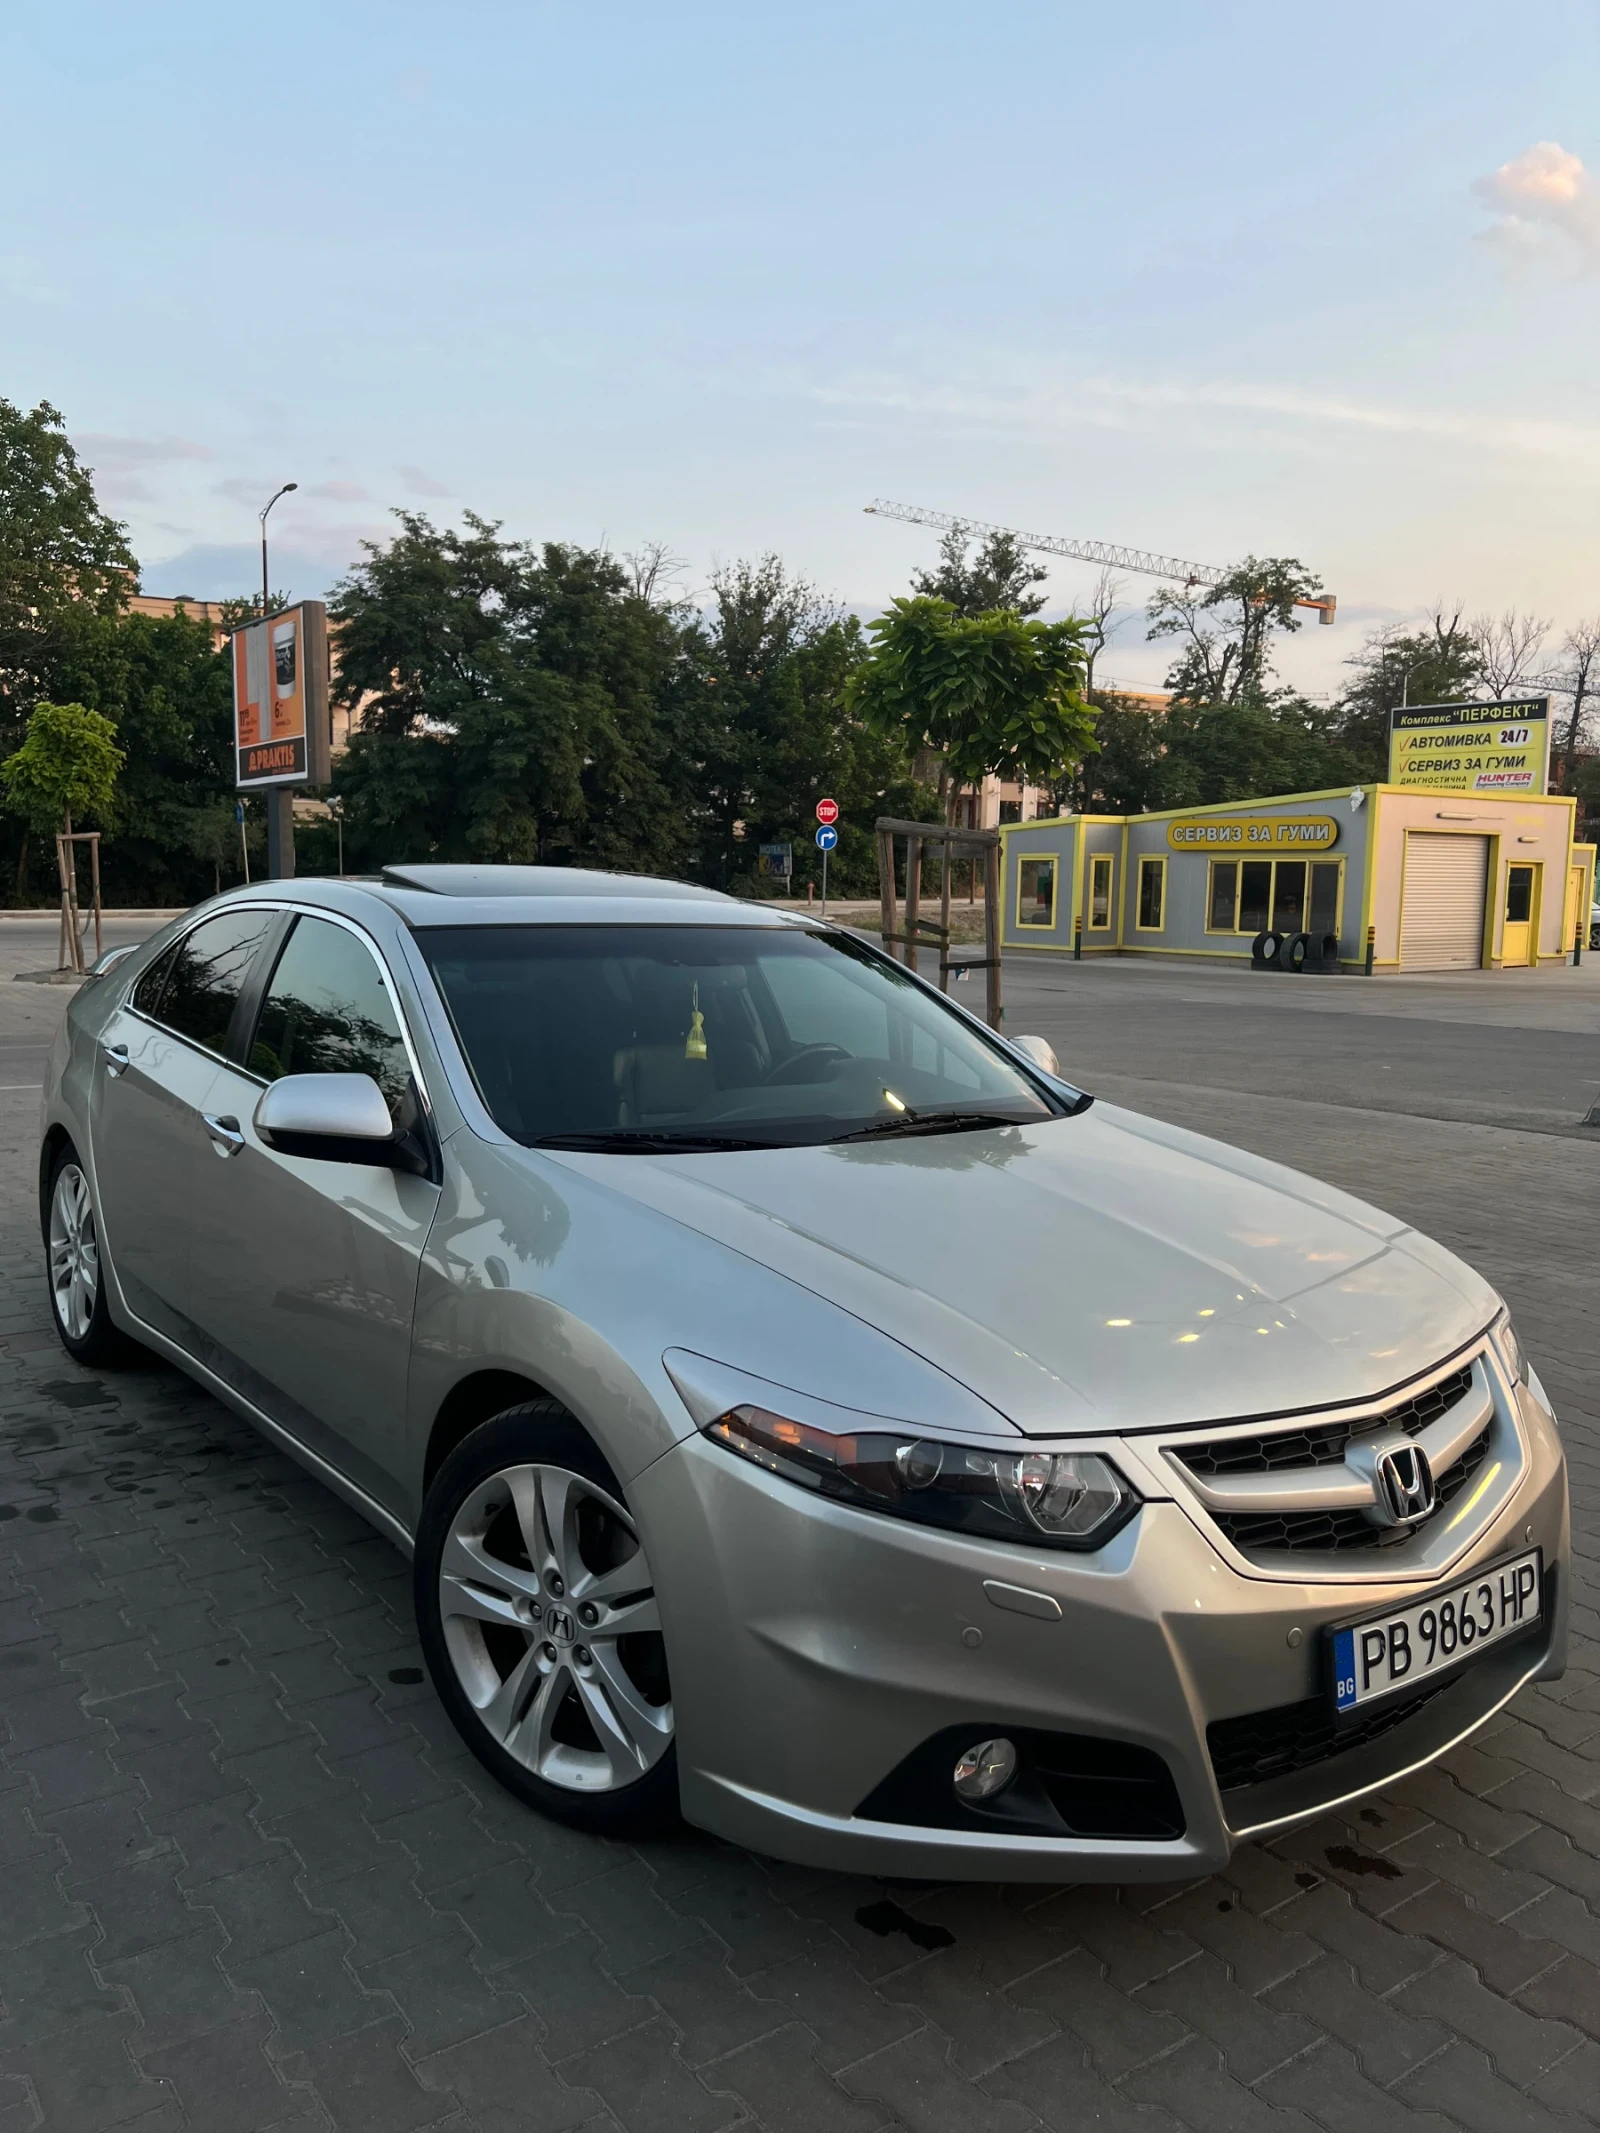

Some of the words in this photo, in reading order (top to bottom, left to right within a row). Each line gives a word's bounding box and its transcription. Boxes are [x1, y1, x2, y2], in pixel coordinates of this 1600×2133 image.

[1400, 714, 1452, 726] Комплекс
[1408, 732, 1491, 749] АВТОМИВКА
[1500, 729, 1528, 743] 24/7
[257, 744, 295, 770] PRAKTIS
[1407, 758, 1461, 773] СЕРВИЗ
[1464, 758, 1482, 770] ЗА
[1485, 755, 1526, 769] ГУМИ
[1399, 775, 1467, 785] ДИАГНОСТИЧНА
[1477, 773, 1532, 783] HUNTER
[819, 807, 836, 816] STOP
[1173, 826, 1243, 843] СЕРВИЗ
[1247, 825, 1272, 842] ЗА
[1276, 824, 1330, 842] ГУМИ
[1359, 1618, 1411, 1691] PB
[1418, 1581, 1495, 1666] 9863
[1498, 1562, 1535, 1628] HP
[1337, 1677, 1354, 1699] BG
